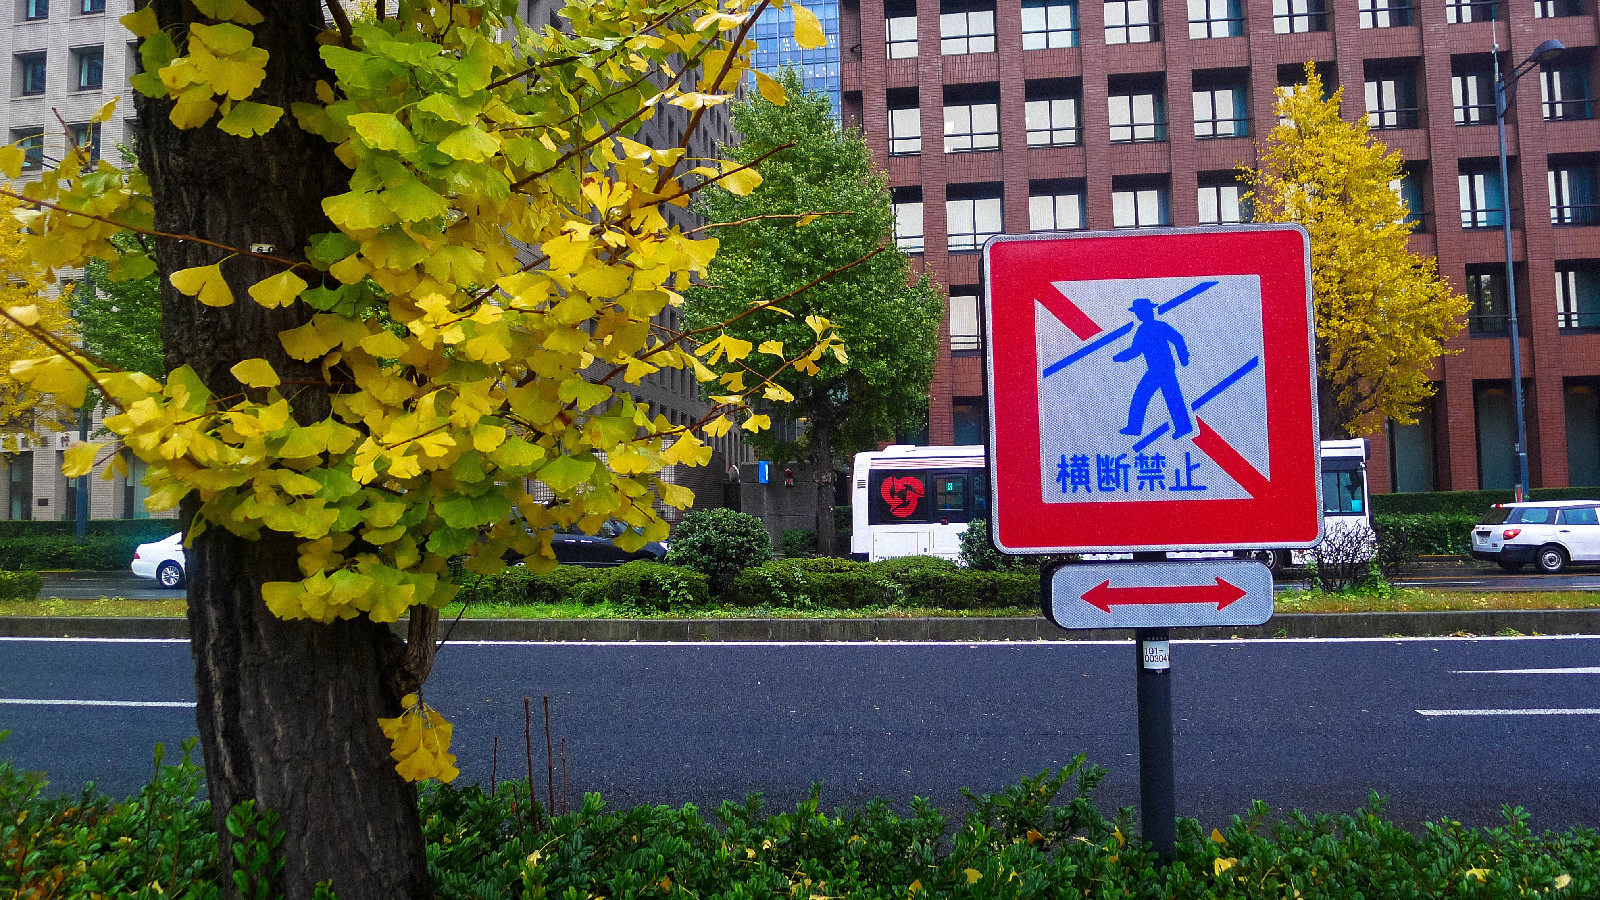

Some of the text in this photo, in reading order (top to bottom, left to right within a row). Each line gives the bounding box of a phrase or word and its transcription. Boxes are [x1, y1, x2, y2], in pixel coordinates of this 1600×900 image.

[1056, 452, 1207, 493] 横断禁止
[1144, 654, 1169, 662] 00304
